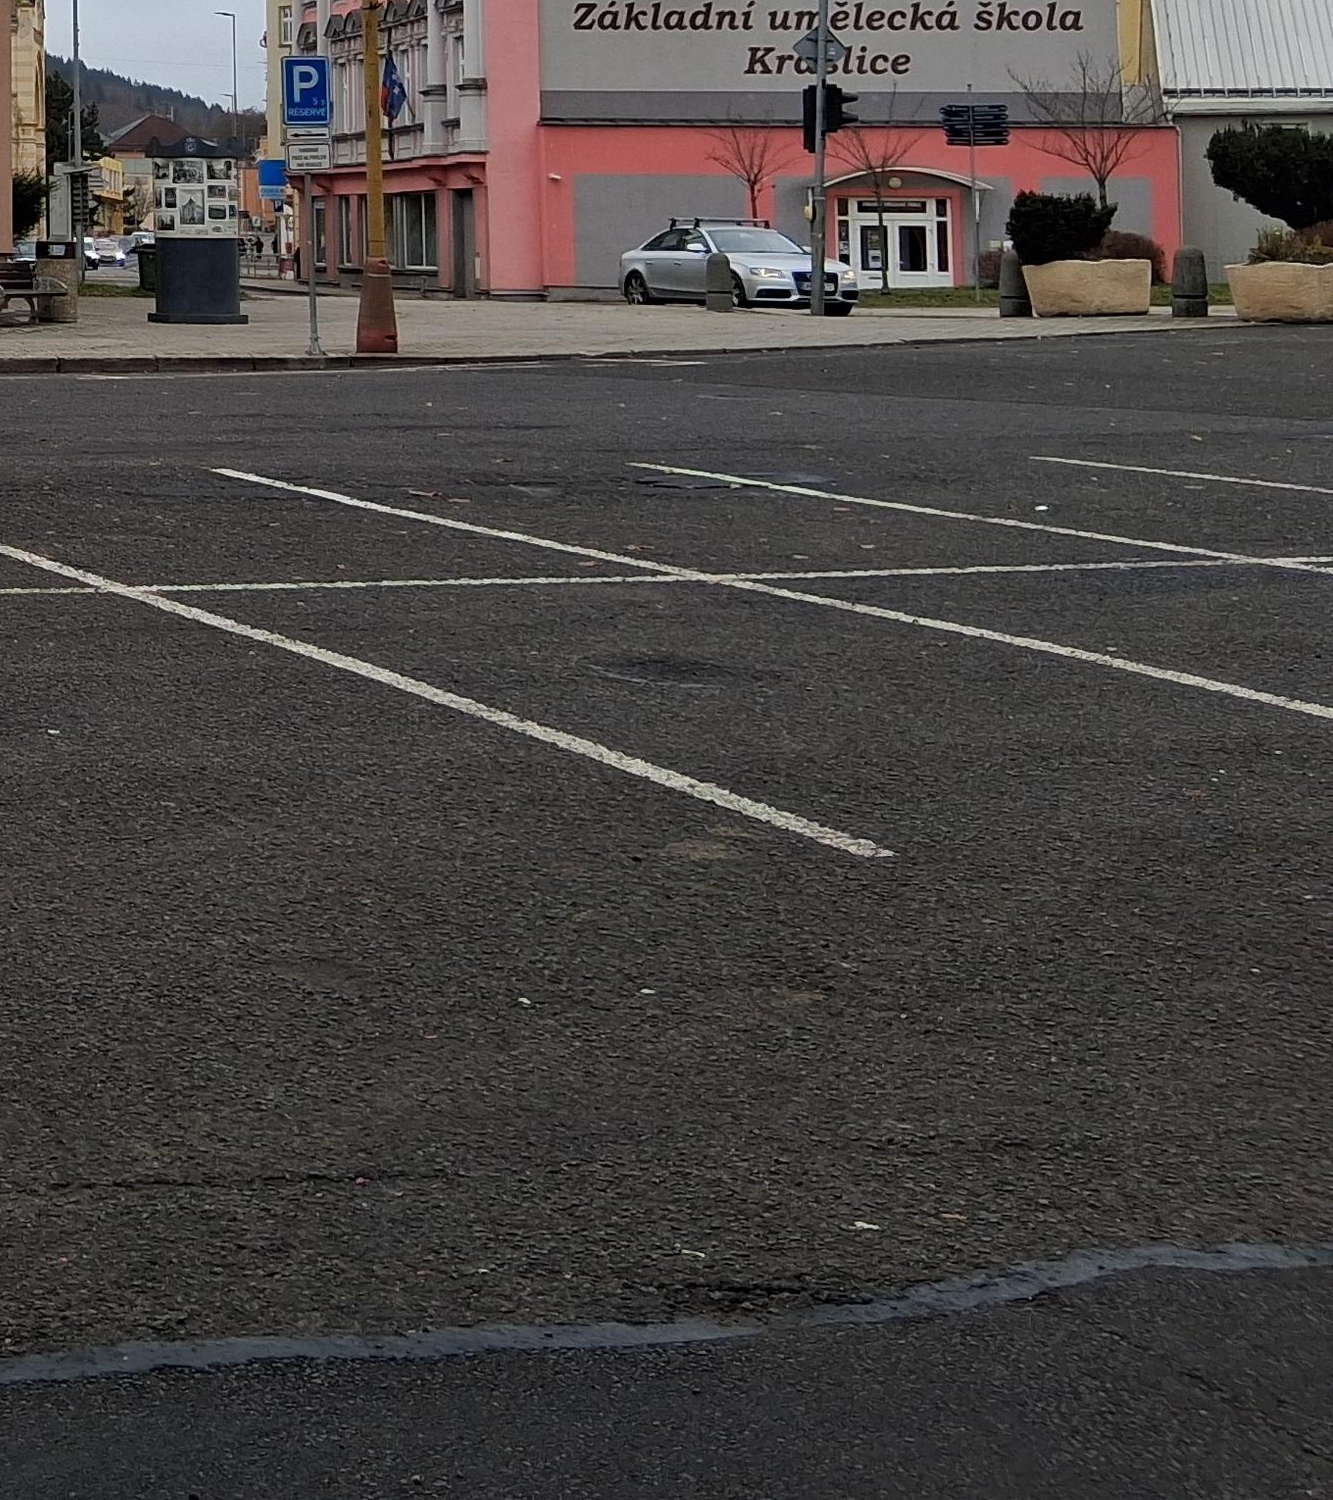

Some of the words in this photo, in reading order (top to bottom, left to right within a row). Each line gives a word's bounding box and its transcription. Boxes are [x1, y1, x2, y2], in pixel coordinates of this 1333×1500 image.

[572, 0, 755, 31] Základní
[767, 0, 961, 31] umělecká
[973, 1, 1084, 32] škola
[293, 65, 319, 102] P
